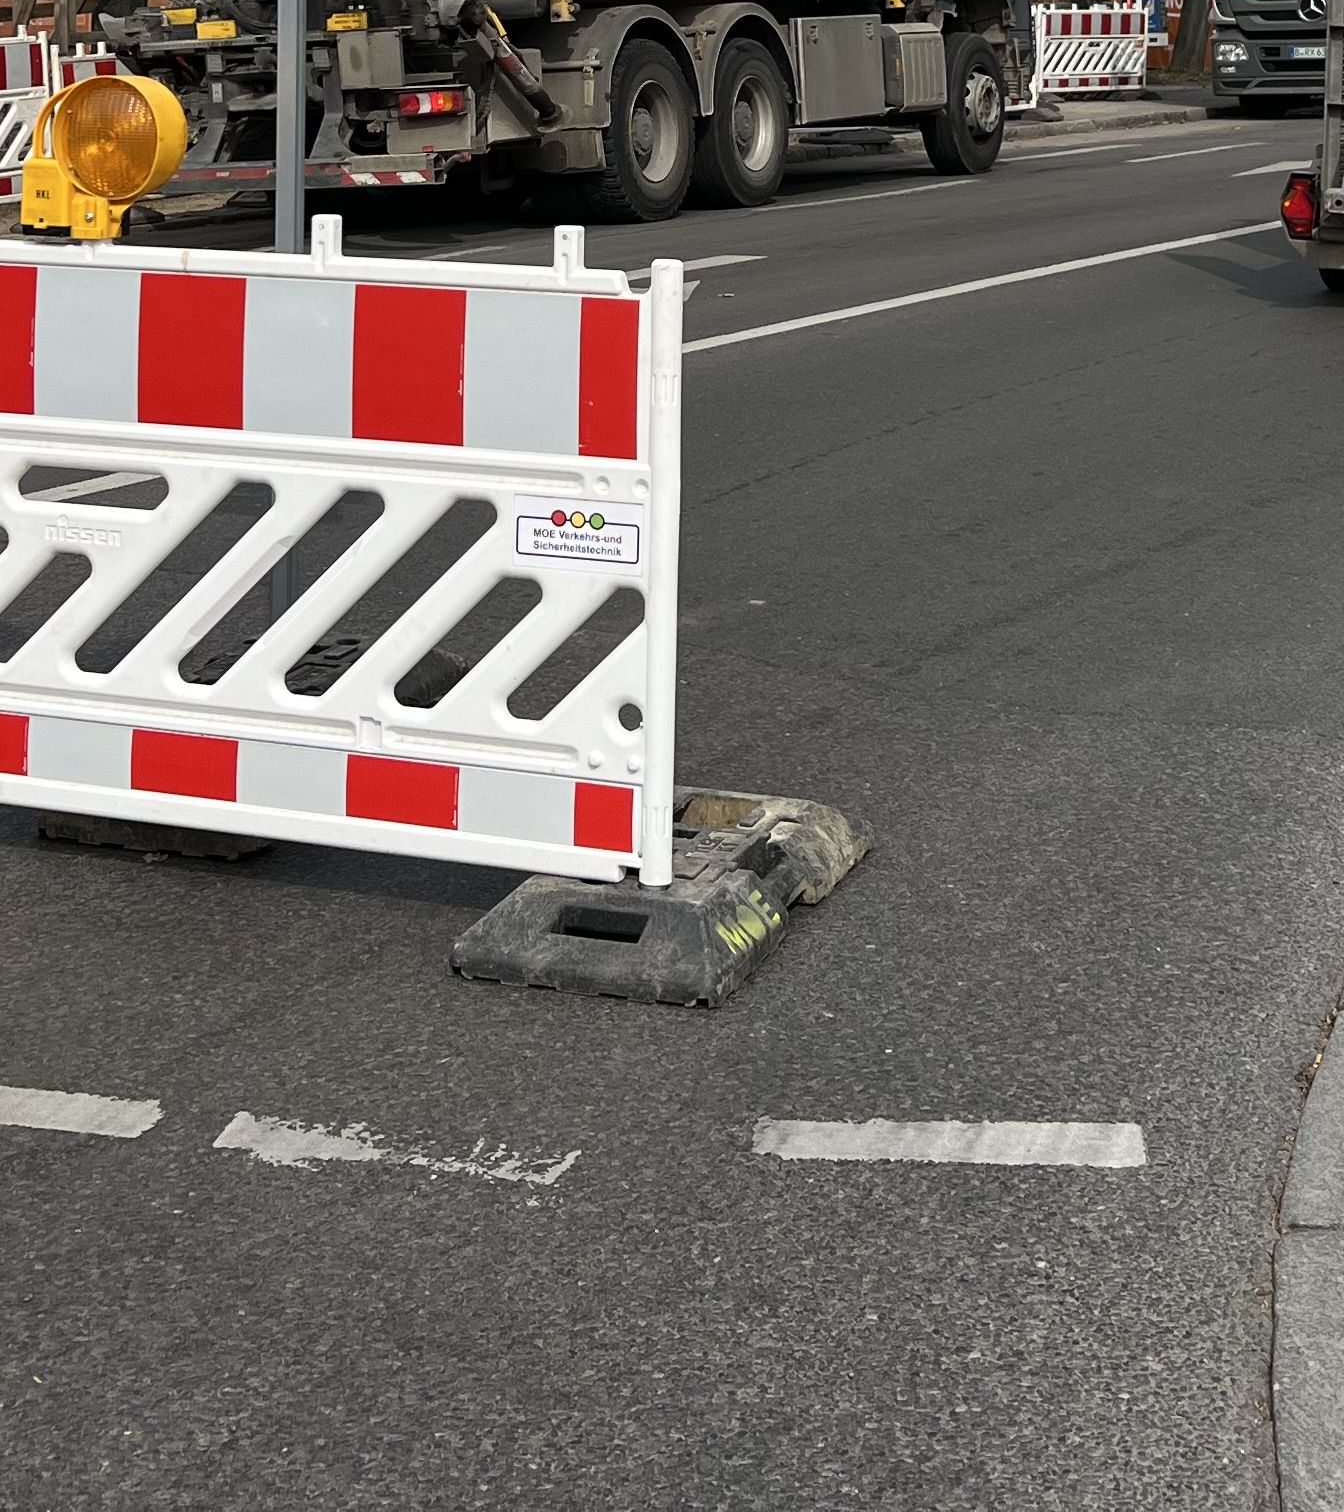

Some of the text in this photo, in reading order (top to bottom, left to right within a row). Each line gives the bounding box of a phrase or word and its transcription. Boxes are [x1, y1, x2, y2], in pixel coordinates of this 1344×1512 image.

[45, 514, 121, 546] nissen
[533, 528, 555, 538] MOE
[533, 540, 622, 556] Sicherheitstechnik
[715, 889, 782, 955] MOE
